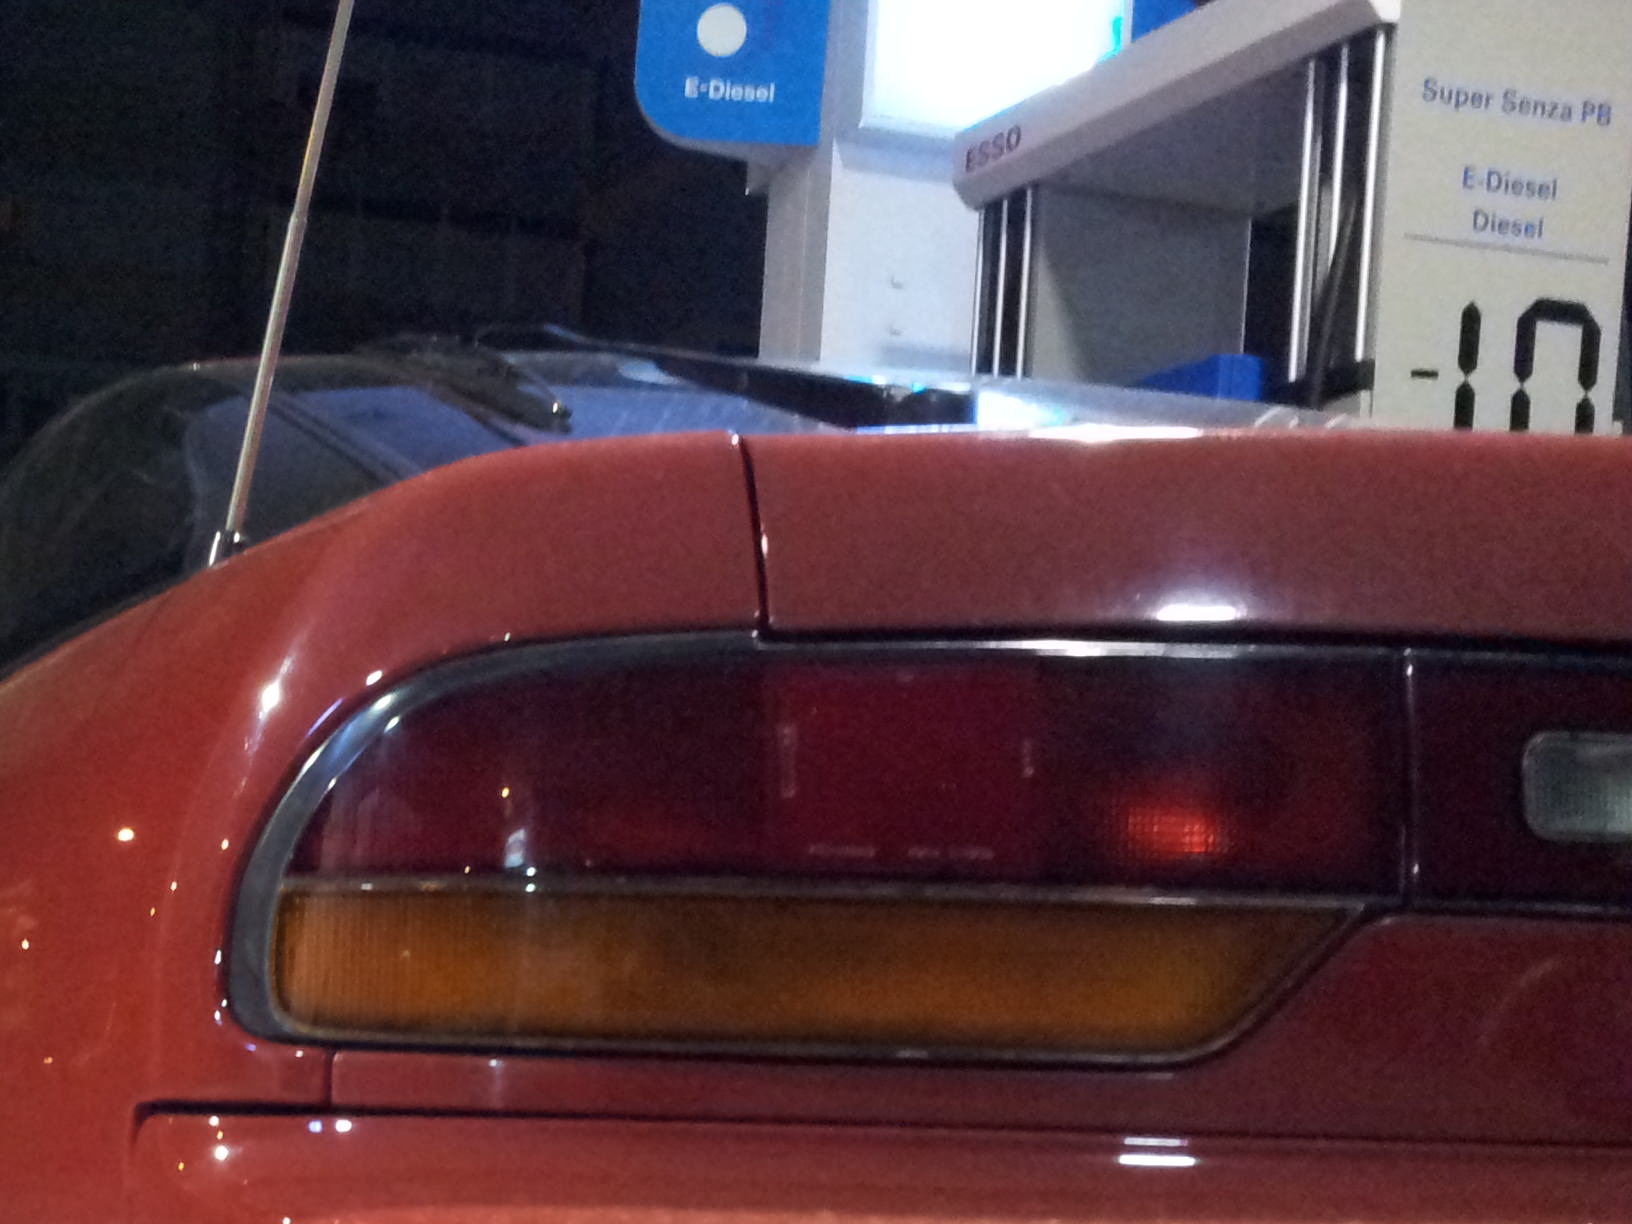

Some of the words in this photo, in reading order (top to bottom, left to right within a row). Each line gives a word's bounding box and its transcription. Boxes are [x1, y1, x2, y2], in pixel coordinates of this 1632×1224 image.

[684, 75, 776, 104] E-Diesel
[1422, 77, 1494, 111] Super
[1502, 88, 1573, 123] Senza
[965, 125, 1022, 172] ESSO
[1462, 165, 1558, 201] E-Diesel
[1472, 208, 1545, 239] Diesel
